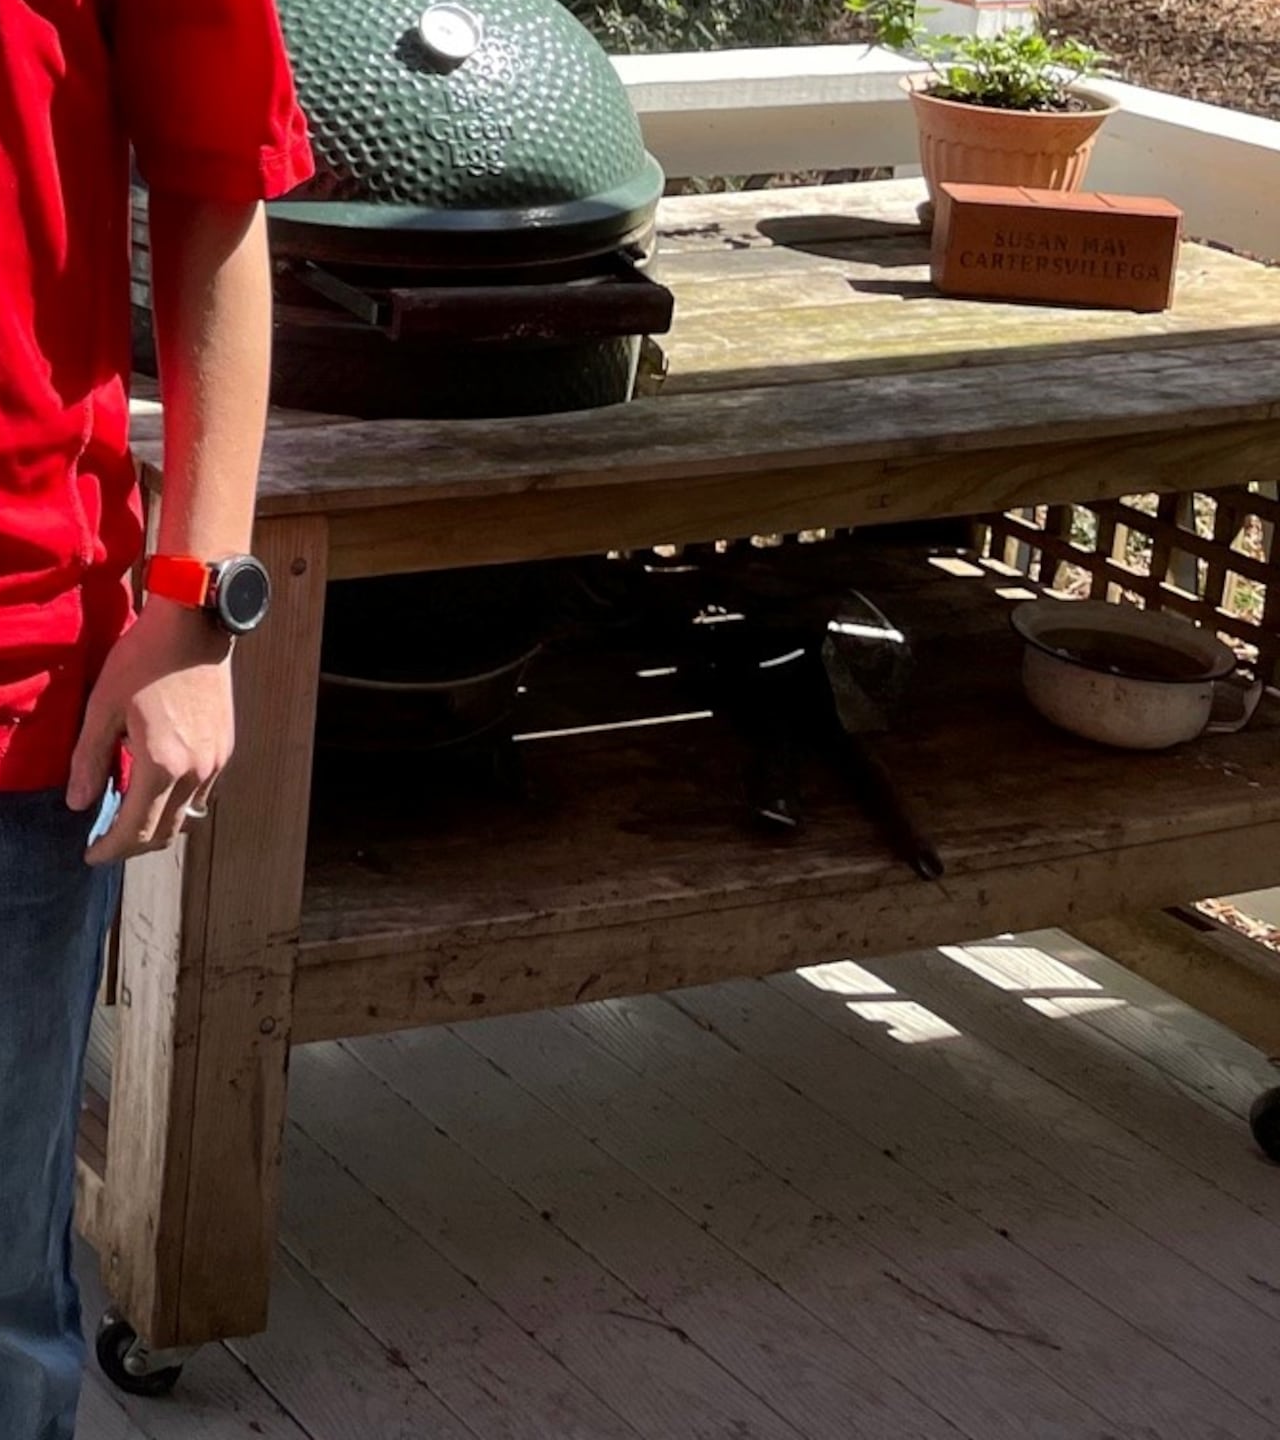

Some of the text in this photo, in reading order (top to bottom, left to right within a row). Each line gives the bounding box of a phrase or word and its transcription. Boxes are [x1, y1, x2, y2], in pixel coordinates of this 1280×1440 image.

[424, 115, 517, 142] Green
[445, 141, 506, 177] Egg
[993, 230, 1129, 257] SUSAN MAY
